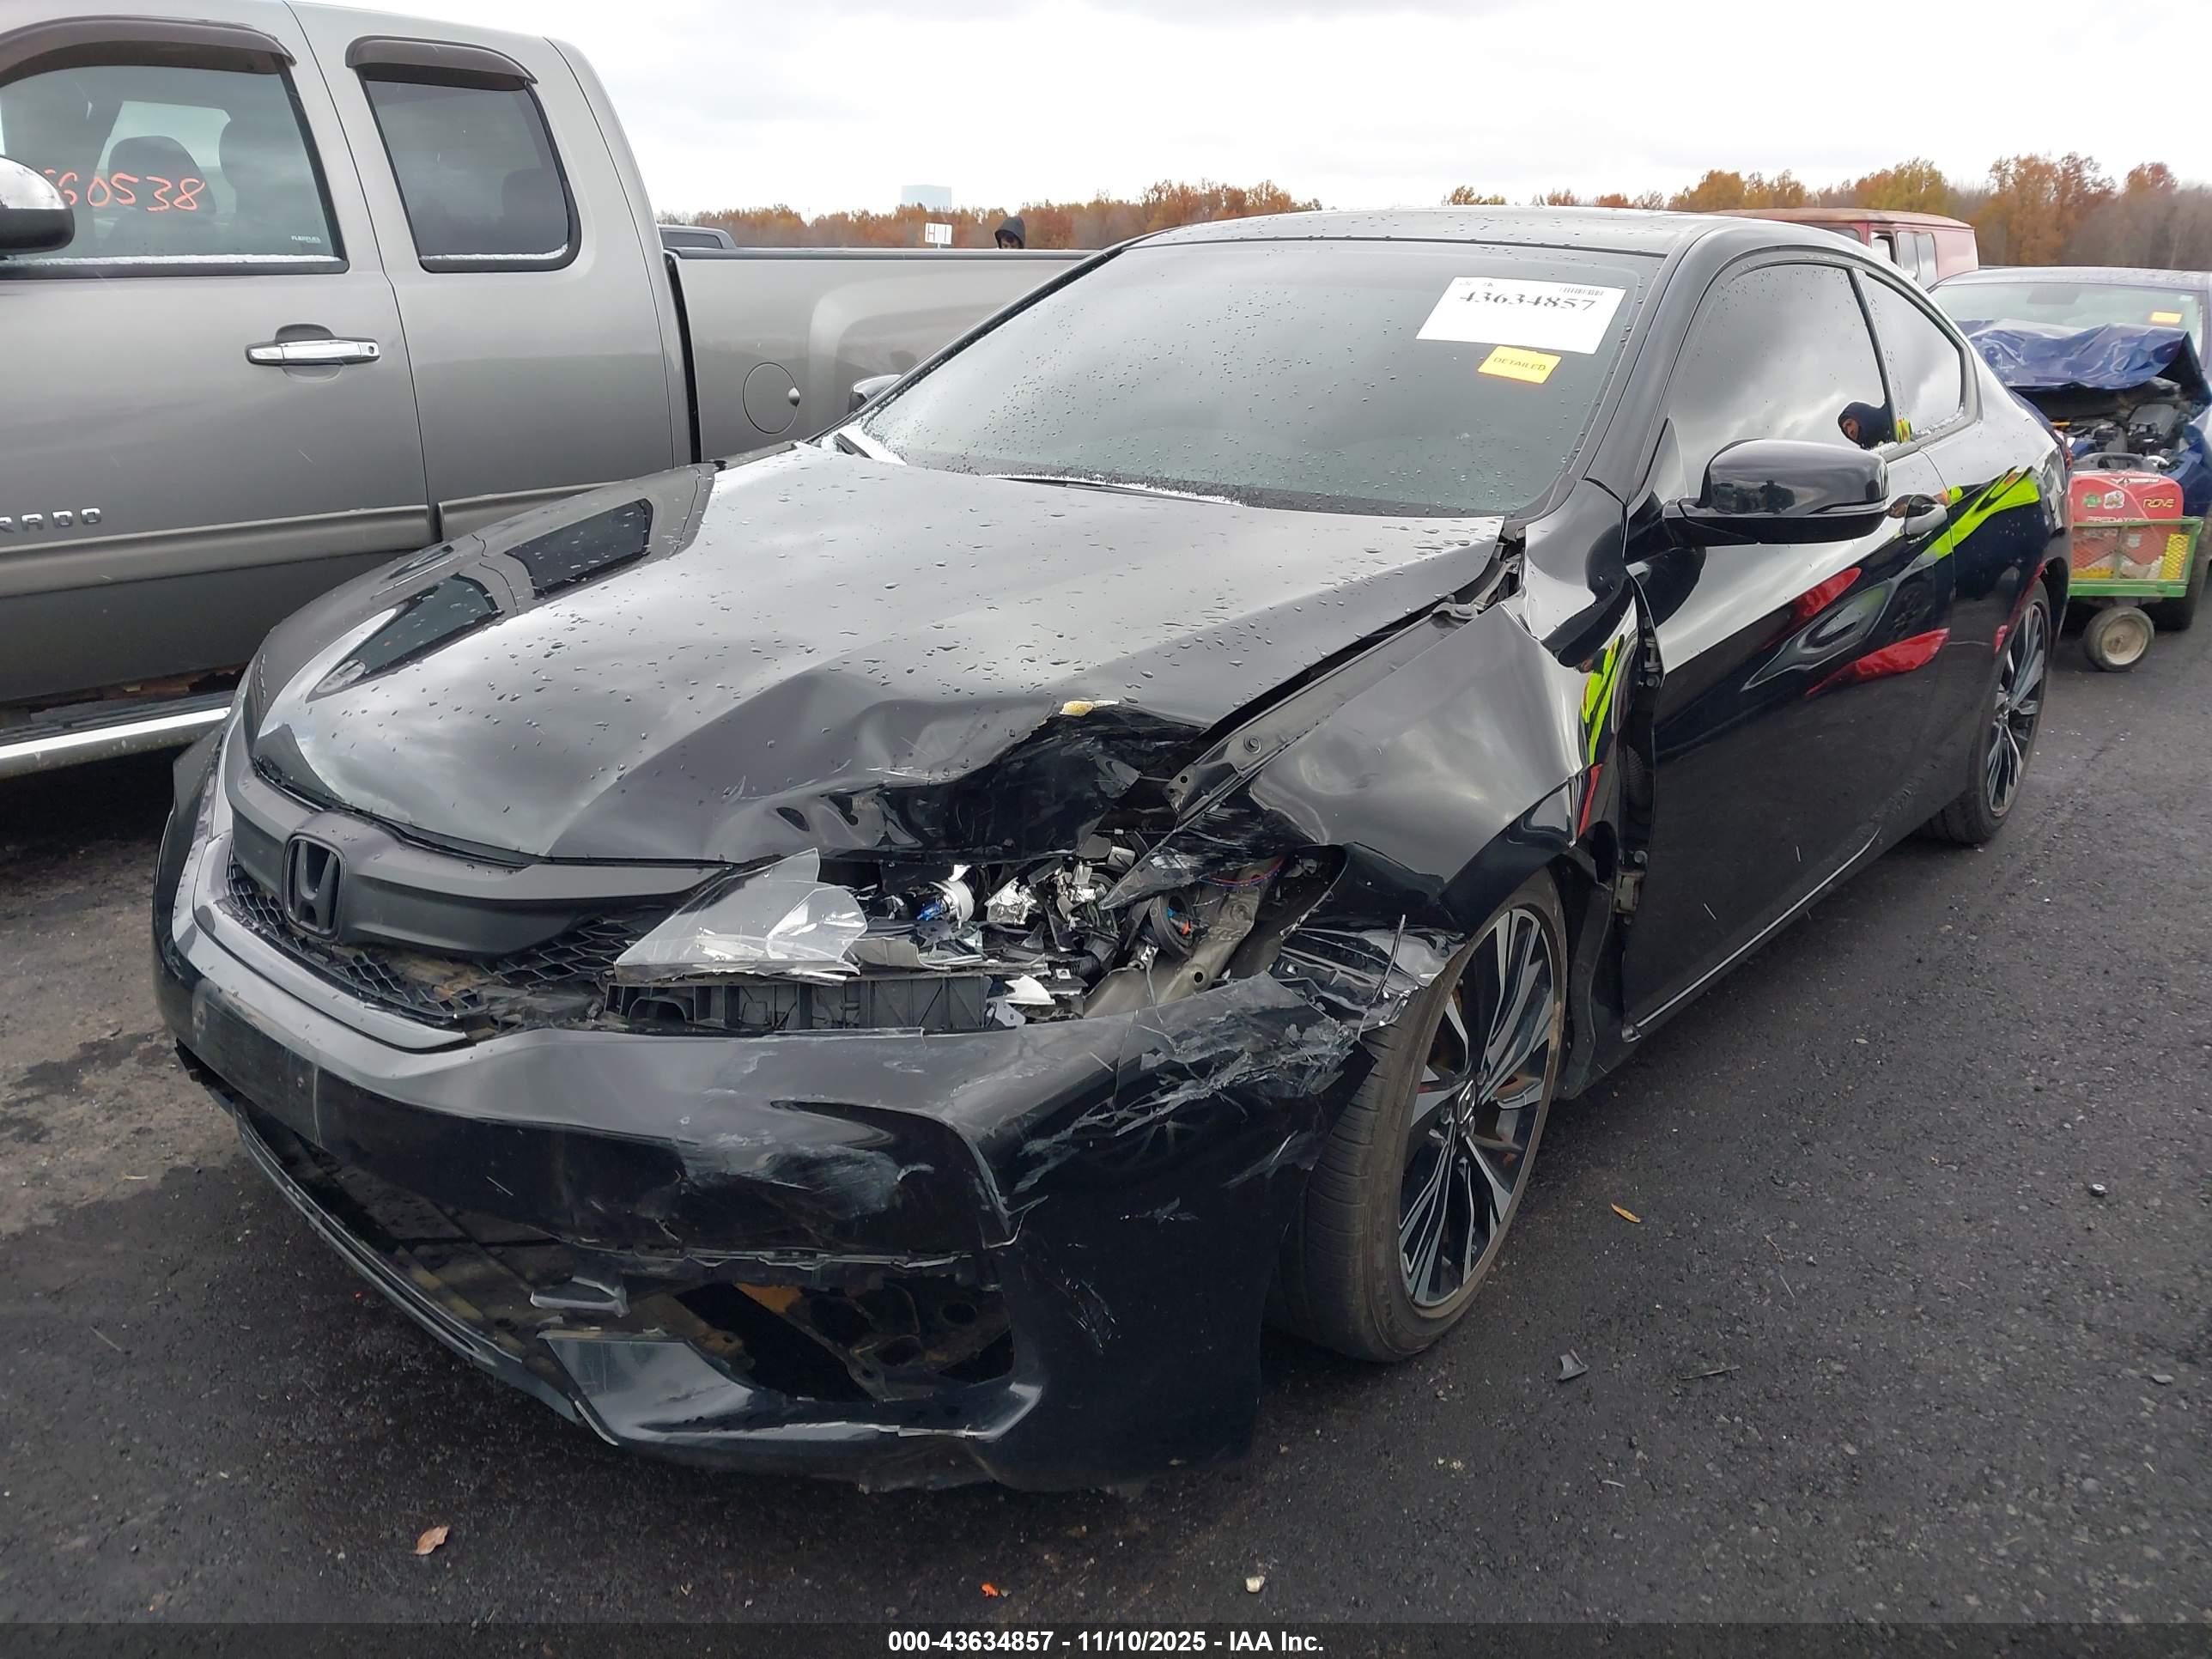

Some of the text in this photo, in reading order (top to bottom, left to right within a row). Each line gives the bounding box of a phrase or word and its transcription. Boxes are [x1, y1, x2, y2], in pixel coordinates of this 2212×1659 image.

[45, 169, 205, 211] 60538
[1460, 291, 1597, 311] 43634857
[1493, 356, 1547, 372] DETAILED
[2142, 498, 2175, 508] ROVE
